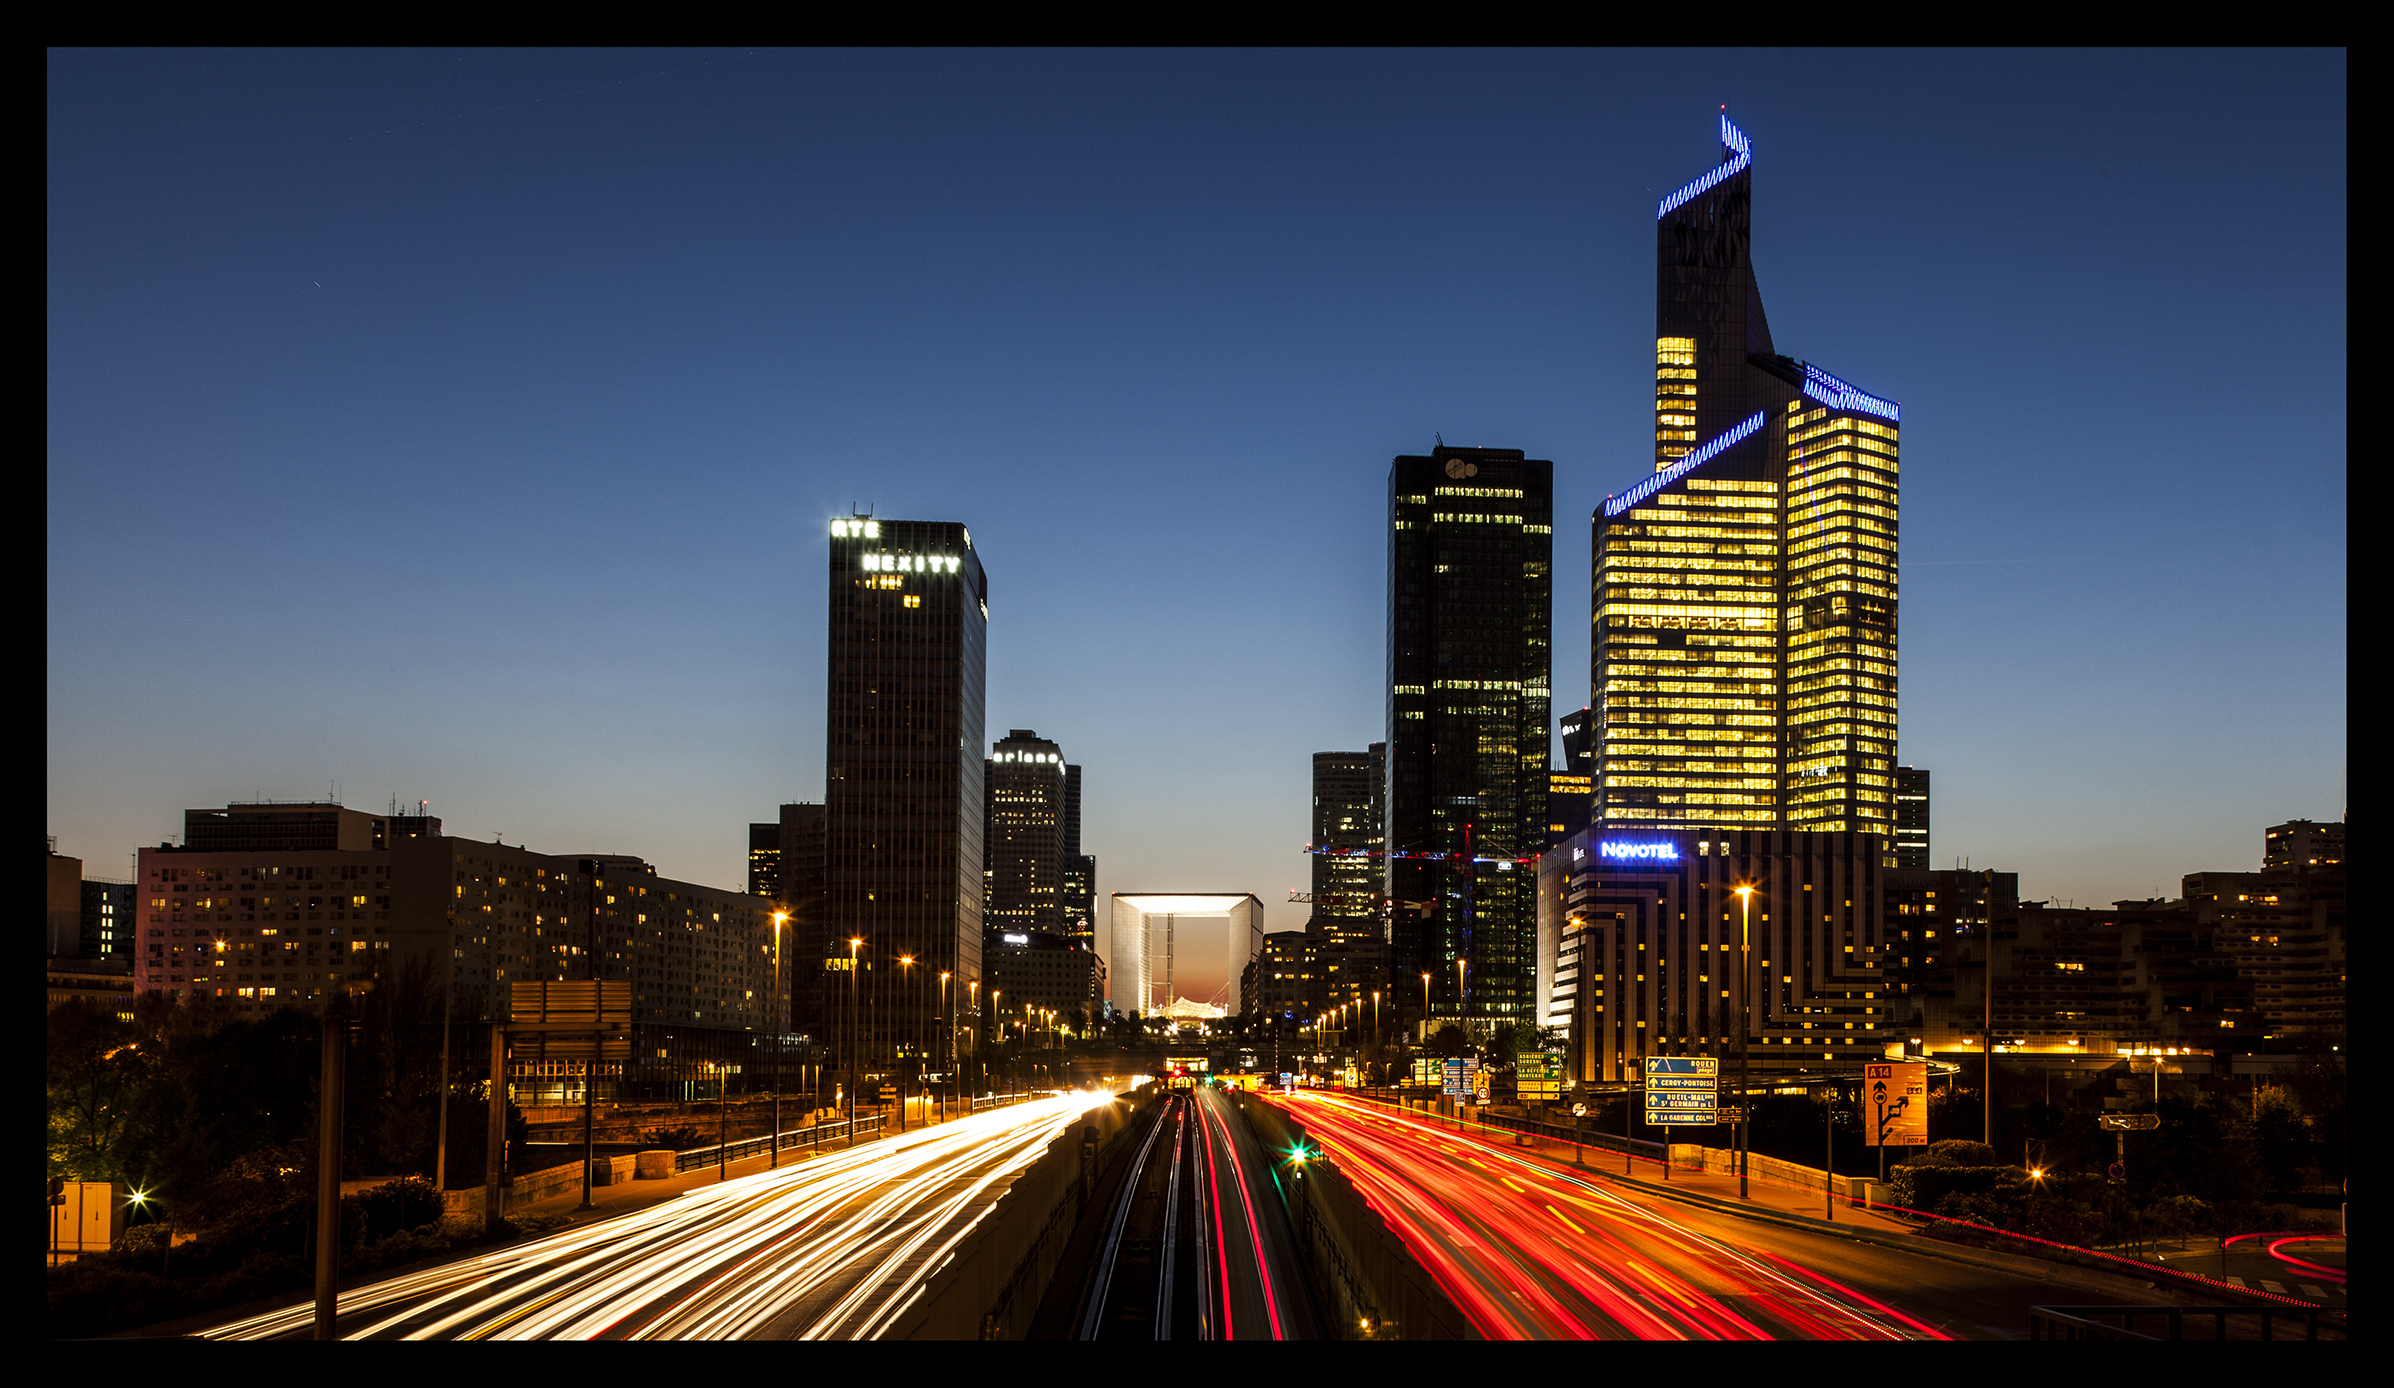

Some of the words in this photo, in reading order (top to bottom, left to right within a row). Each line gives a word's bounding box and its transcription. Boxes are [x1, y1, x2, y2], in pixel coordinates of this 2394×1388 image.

[832, 520, 879, 538] RTE
[862, 554, 960, 573] NEXITY
[1601, 842, 1678, 859] NOVOTEL
[1660, 1079, 1714, 1087] CERGY-PONTOISE
